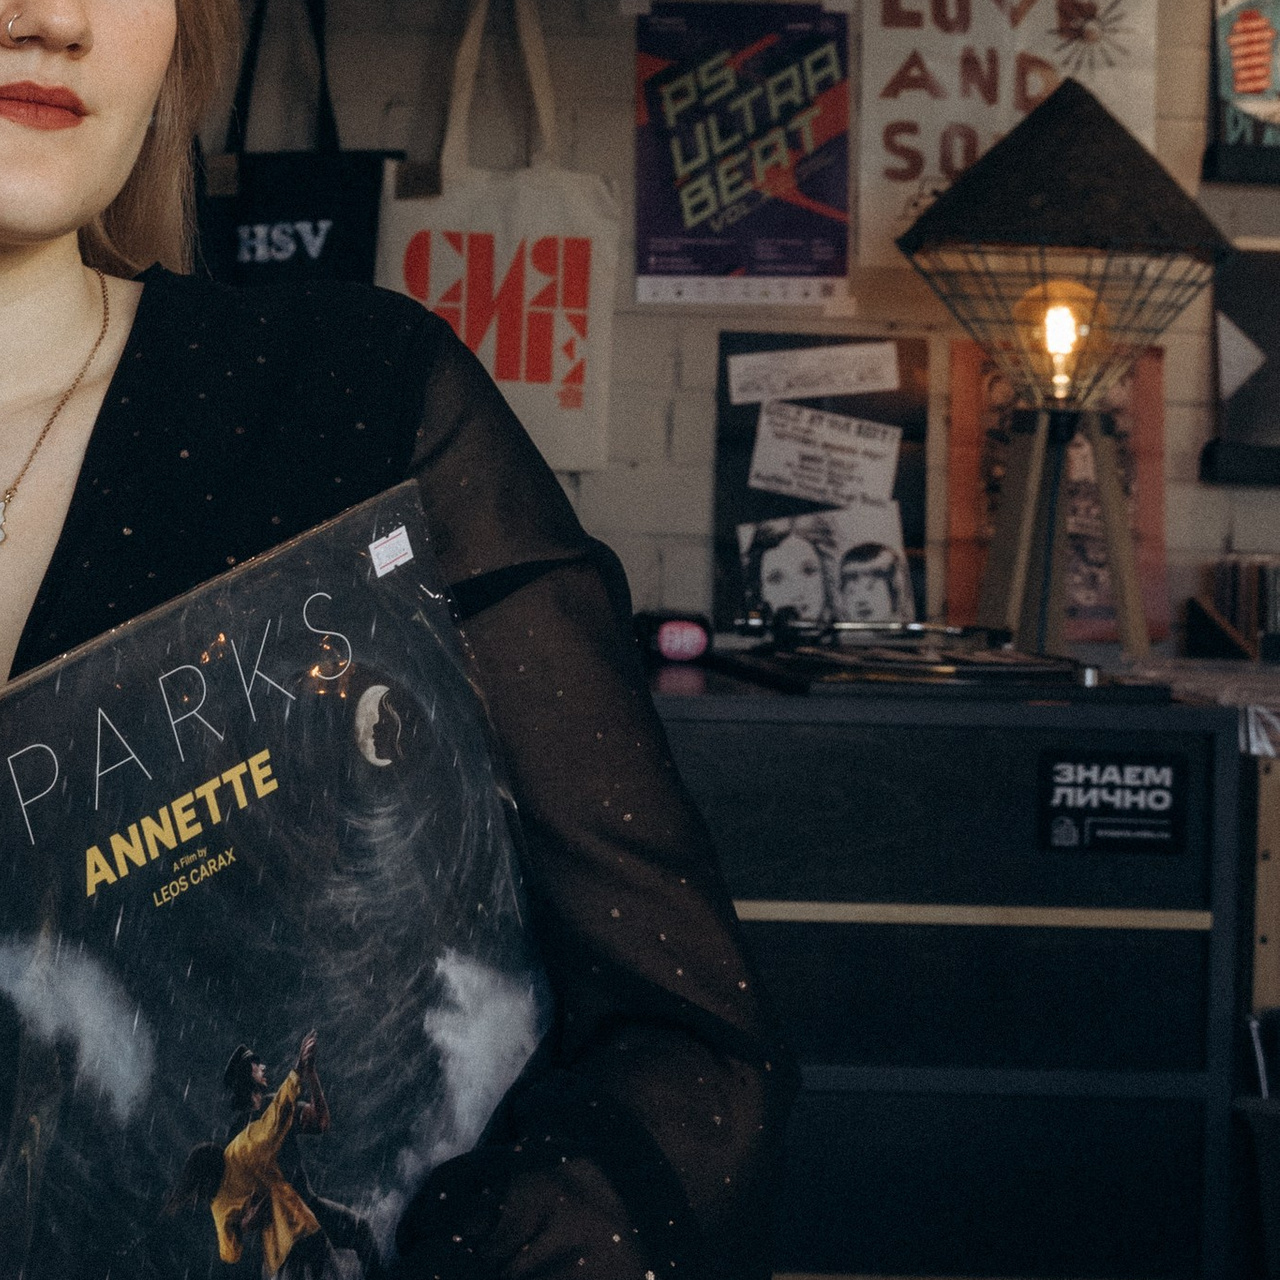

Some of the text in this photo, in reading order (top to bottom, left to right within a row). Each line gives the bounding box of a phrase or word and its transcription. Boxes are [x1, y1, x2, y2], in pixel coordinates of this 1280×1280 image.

[659, 48, 739, 127] PS
[670, 40, 843, 179] ULTRA
[879, 46, 1060, 114] AND
[679, 104, 825, 229] BEAT
[882, 120, 979, 182] SO
[237, 220, 333, 263] HSV
[1050, 785, 1173, 811] ЛИЧНО
[1052, 762, 1174, 788] ЗНАЕМ
[84, 748, 279, 896] ANNETTE
[152, 847, 236, 907] LEOS CARAX
[173, 846, 208, 873] A Film by
